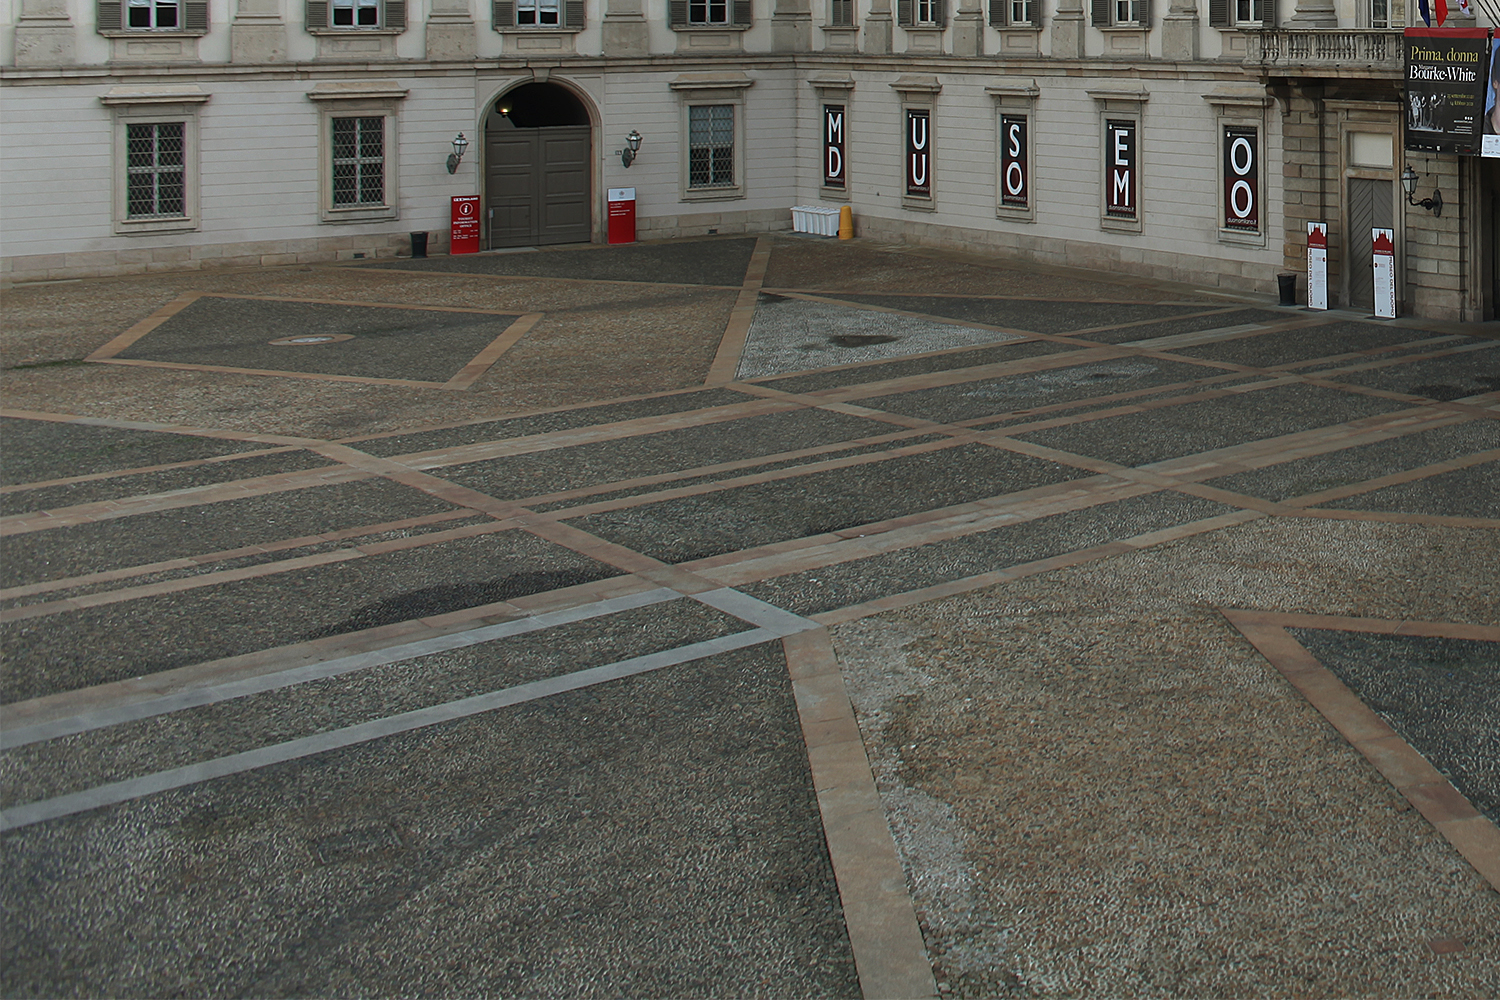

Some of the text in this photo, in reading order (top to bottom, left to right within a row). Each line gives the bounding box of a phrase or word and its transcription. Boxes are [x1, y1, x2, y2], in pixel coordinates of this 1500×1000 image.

[1409, 64, 1476, 82] Bourke-White
[1410, 45, 1479, 63] Prima, donna
[828, 113, 1252, 176] M U S E O
[828, 146, 1253, 218] D U O M O
